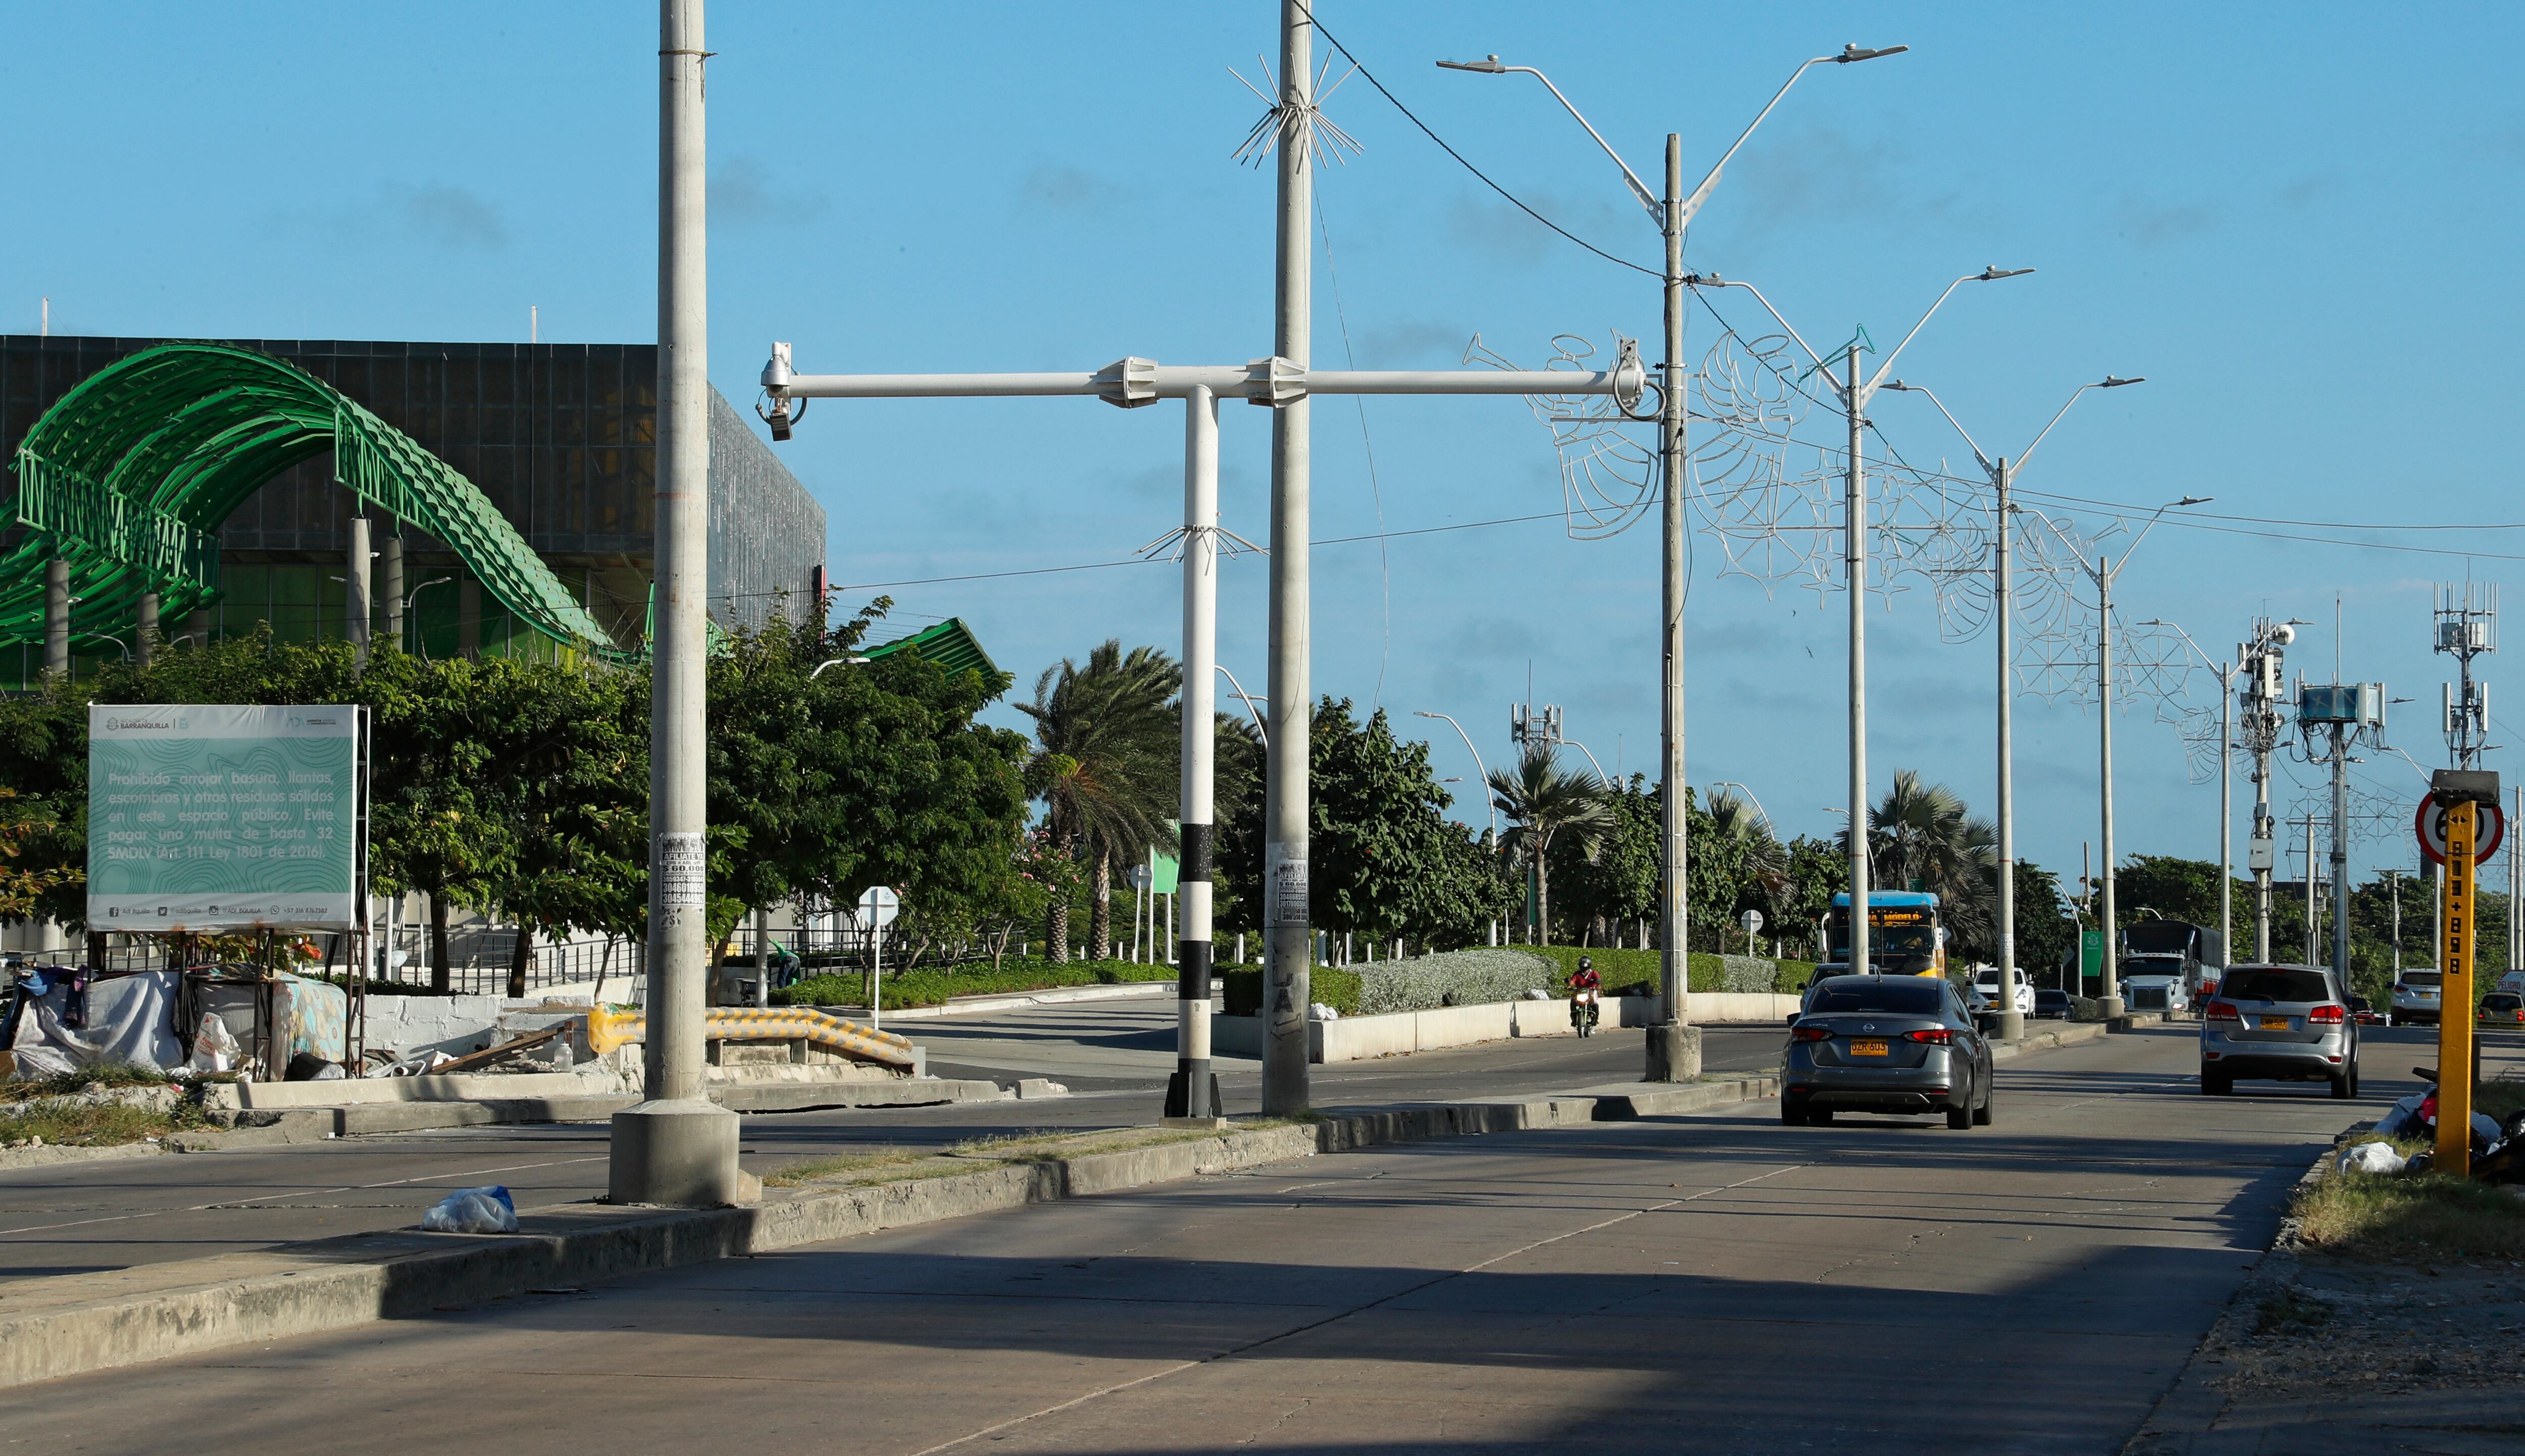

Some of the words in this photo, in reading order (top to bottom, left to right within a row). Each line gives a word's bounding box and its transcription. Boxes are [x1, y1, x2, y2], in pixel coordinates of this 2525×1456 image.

[109, 772, 170, 784] Prohibido
[179, 772, 223, 787] arrojar
[231, 771, 280, 786] basura,
[289, 770, 334, 785] llantas,
[109, 791, 179, 803] escombros
[183, 793, 191, 806] y
[195, 792, 227, 803] otros
[231, 790, 285, 802] residuos
[289, 790, 334, 802] sólidos
[108, 812, 124, 822] en
[138, 810, 166, 822] este
[178, 809, 228, 824] espacio
[242, 808, 291, 824] público.
[305, 808, 334, 820] Evite
[108, 831, 147, 844] pagar
[159, 831, 184, 840] una
[195, 827, 231, 840] multa
[242, 827, 260, 839] de
[270, 826, 306, 840] hasta
[317, 827, 333, 839] 32
[108, 846, 152, 859] SMDLV
[157, 846, 181, 859] (Art.
[187, 846, 203, 858] 111
[210, 846, 231, 861] Ley
[236, 846, 262, 858] 1801
[269, 845, 285, 858] de
[289, 845, 326, 858] 2016).
[2498, 981, 2520, 990] PELIGRO
